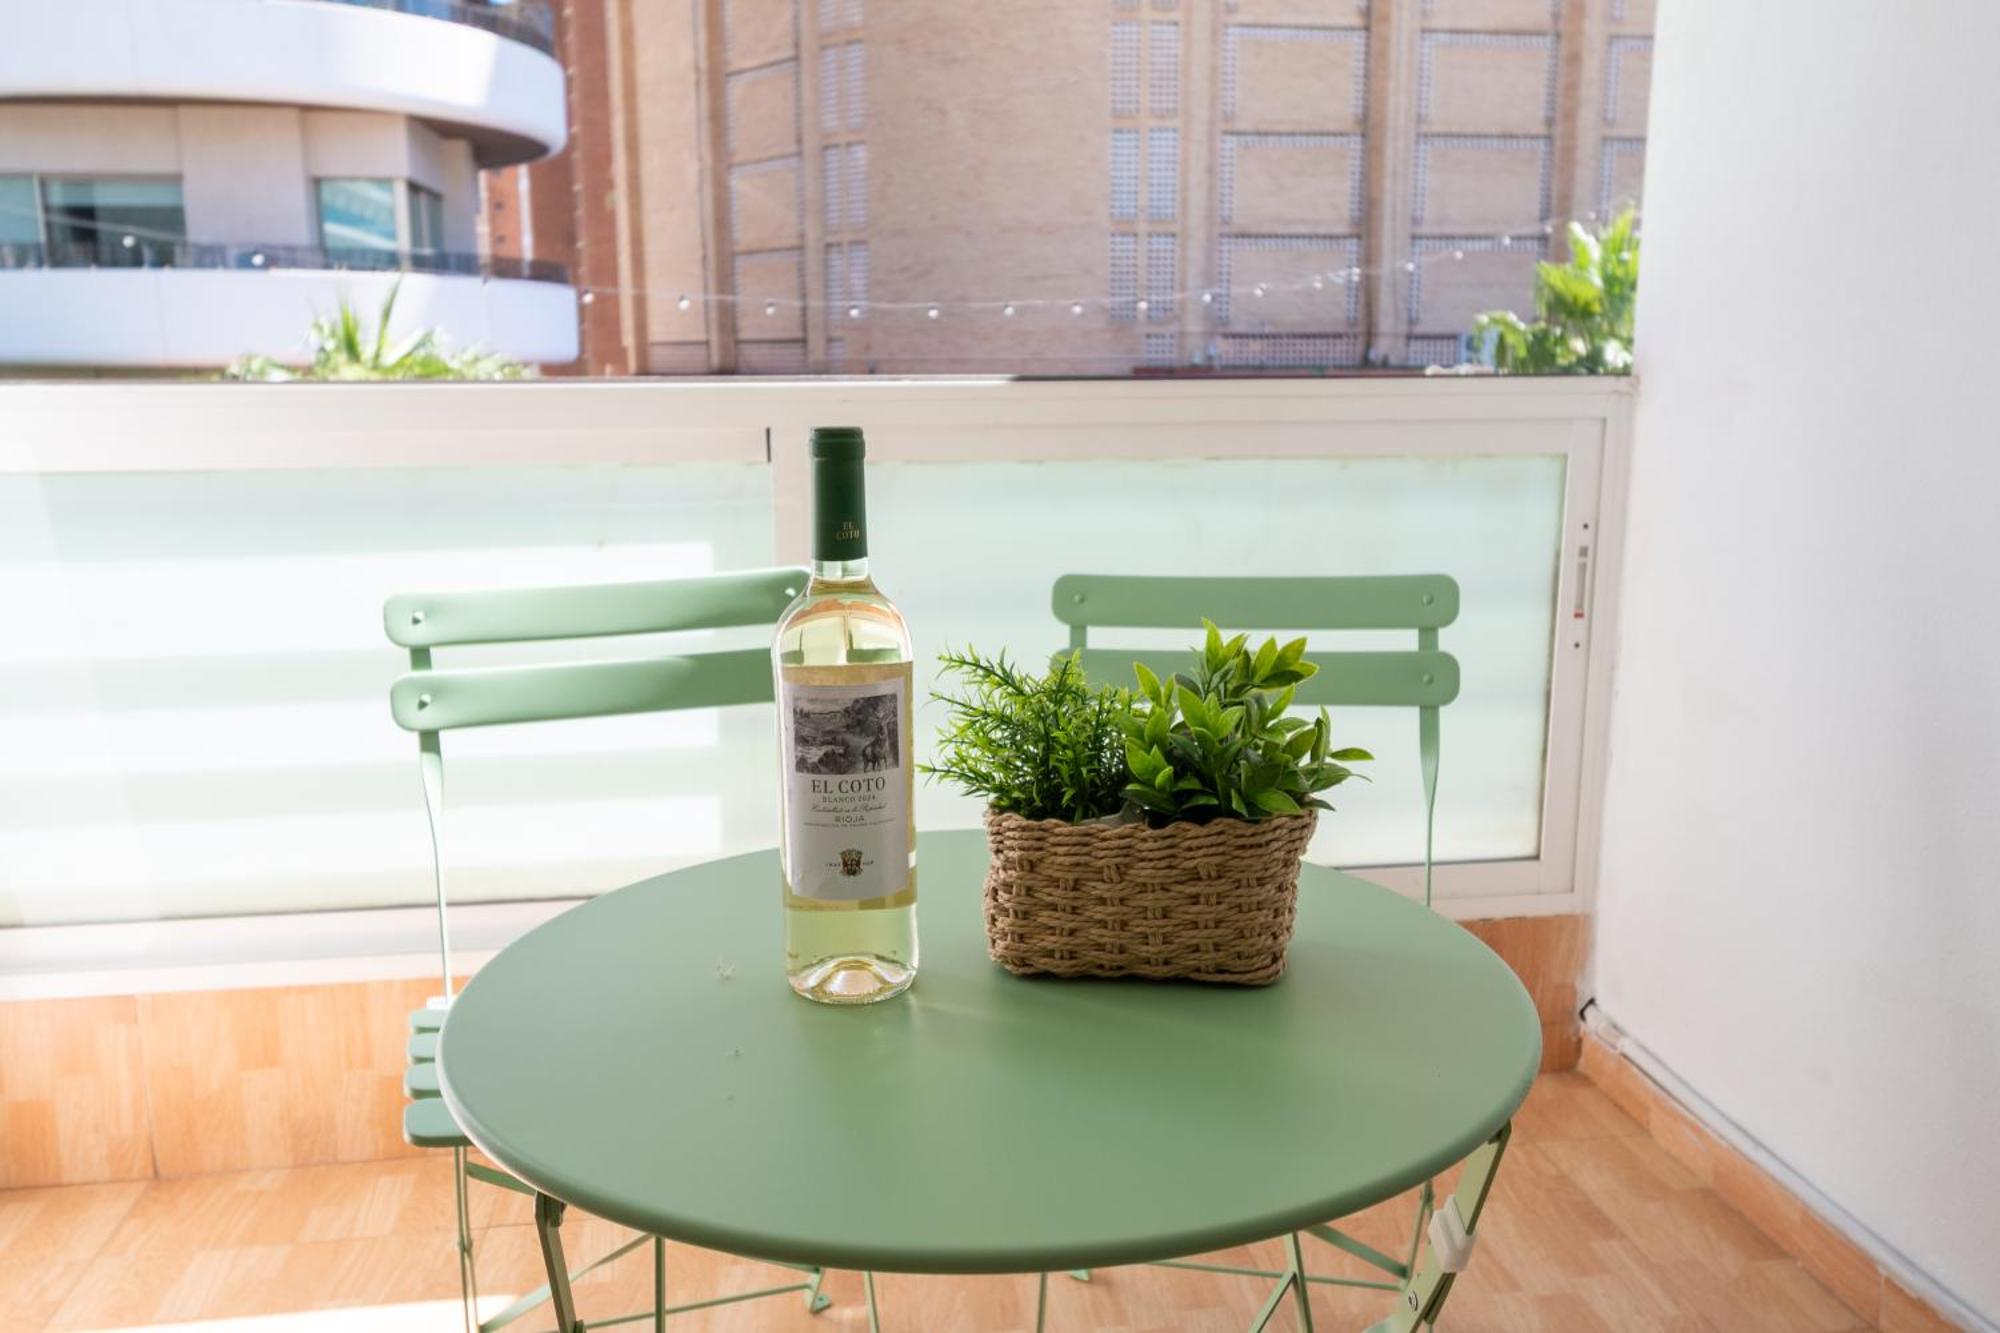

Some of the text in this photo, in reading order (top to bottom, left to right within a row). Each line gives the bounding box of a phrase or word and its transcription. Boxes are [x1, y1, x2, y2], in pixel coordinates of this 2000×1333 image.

[812, 776, 885, 793] EL COTO
[834, 815, 864, 823] RIOJA
